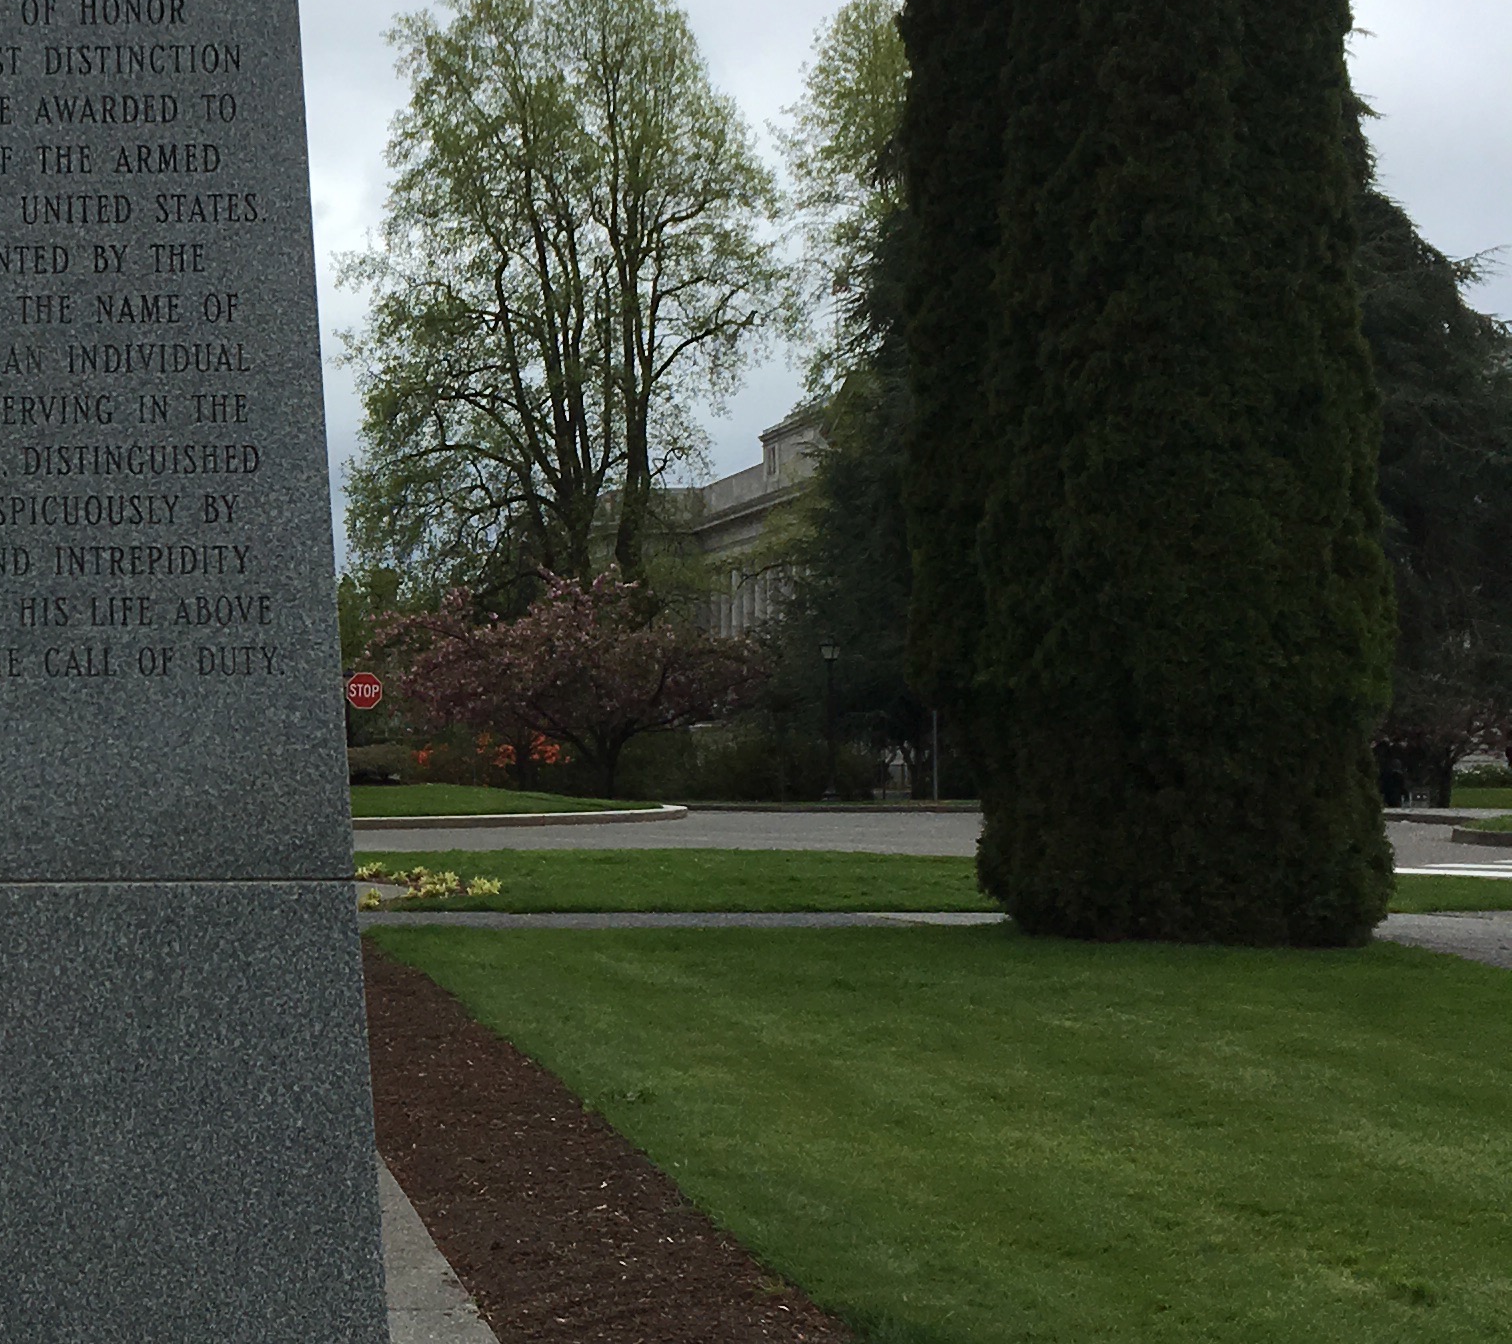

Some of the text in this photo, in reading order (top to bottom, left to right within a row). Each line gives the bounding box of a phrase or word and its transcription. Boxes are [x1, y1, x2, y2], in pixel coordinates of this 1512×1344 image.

[44, 44, 241, 76] DISTINCTION
[35, 95, 179, 125] AWARDED
[201, 94, 237, 123] TO
[37, 145, 93, 175] THE
[113, 144, 221, 174] ARMED
[21, 195, 131, 225] UNITED
[93, 245, 126, 274] BY
[150, 244, 205, 273] THE
[17, 295, 72, 325] THE
[96, 294, 181, 324] NAME
[203, 293, 240, 323] OF
[1, 346, 38, 376] AN
[68, 344, 250, 375] INDIVIDUAL
[138, 395, 167, 424] IN
[192, 394, 248, 424] THE
[23, 445, 260, 477] DISTINGUISHED
[203, 495, 240, 524] BY
[54, 545, 249, 576] INTREPIDITY
[19, 597, 68, 627] HIS
[90, 596, 151, 626] LIFE
[174, 595, 273, 626] ABOVE
[44, 647, 117, 677] CALL
[138, 646, 174, 676] OF
[349, 683, 380, 698] STOP
